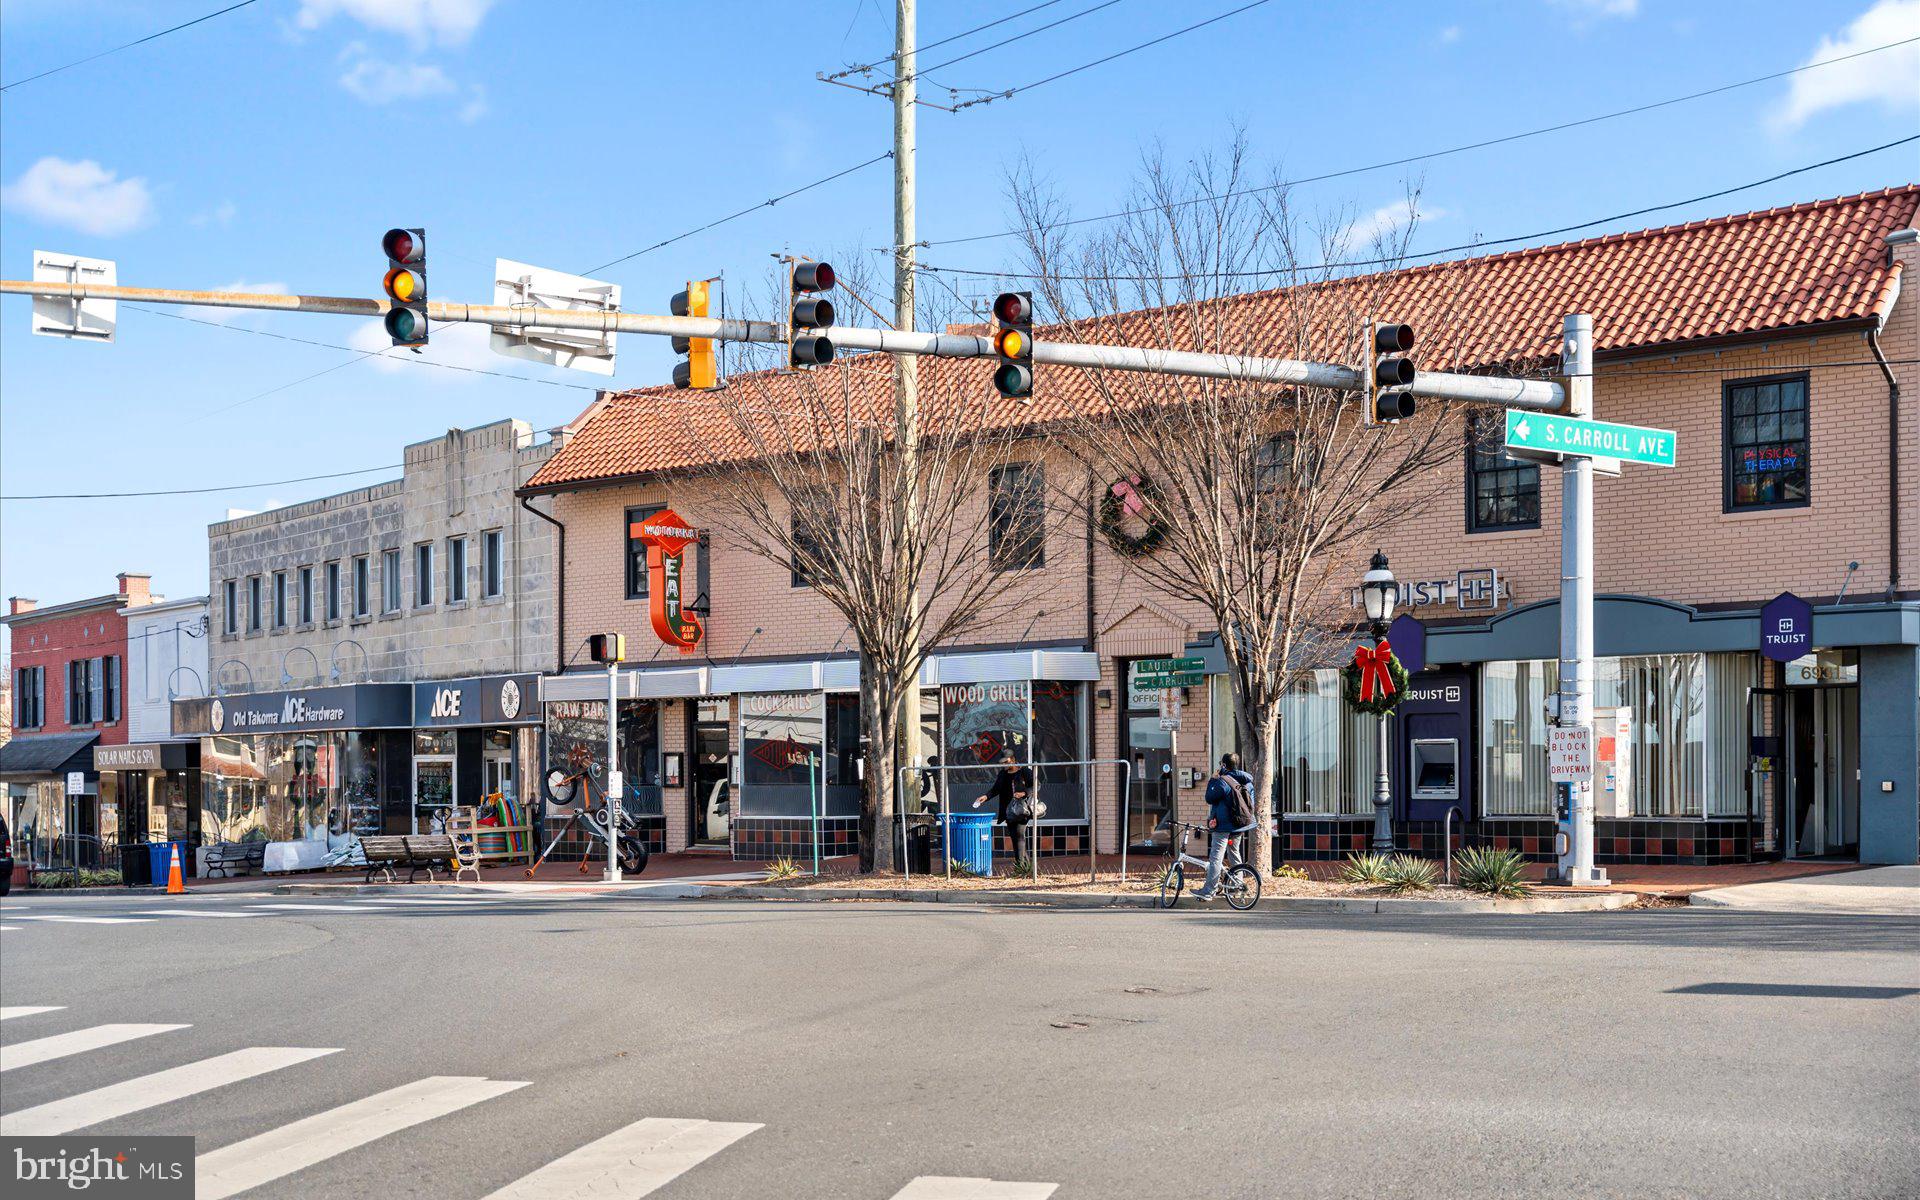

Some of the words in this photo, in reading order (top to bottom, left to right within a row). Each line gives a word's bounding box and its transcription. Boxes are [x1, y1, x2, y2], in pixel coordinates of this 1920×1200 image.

[1545, 423, 1559, 443] S.
[1564, 426, 1631, 452] CARROLL
[1638, 436, 1669, 457] AVE.
[665, 558, 680, 618] EAT
[1766, 633, 1806, 645] TRUIST
[1140, 660, 1177, 673] LAUREL
[1151, 675, 1194, 688] CARROLL
[430, 685, 462, 718] ACE
[943, 685, 986, 704] WOOD
[989, 683, 1028, 702] GRILL
[233, 710, 247, 727] Old
[248, 710, 279, 726] Takoma
[280, 694, 306, 725] ACE
[305, 706, 345, 721] Hardware
[556, 702, 580, 718] RAW
[582, 702, 606, 719] BAR
[750, 693, 812, 713] COCKTAILS
[1554, 732, 1566, 740] DO
[1571, 731, 1588, 739] NOT
[1552, 743, 1587, 751] BLOCK
[98, 751, 118, 766] SOLAR
[142, 749, 155, 765] SPA
[1562, 754, 1580, 762] THE
[1551, 765, 1591, 774] DRIVEWAY
